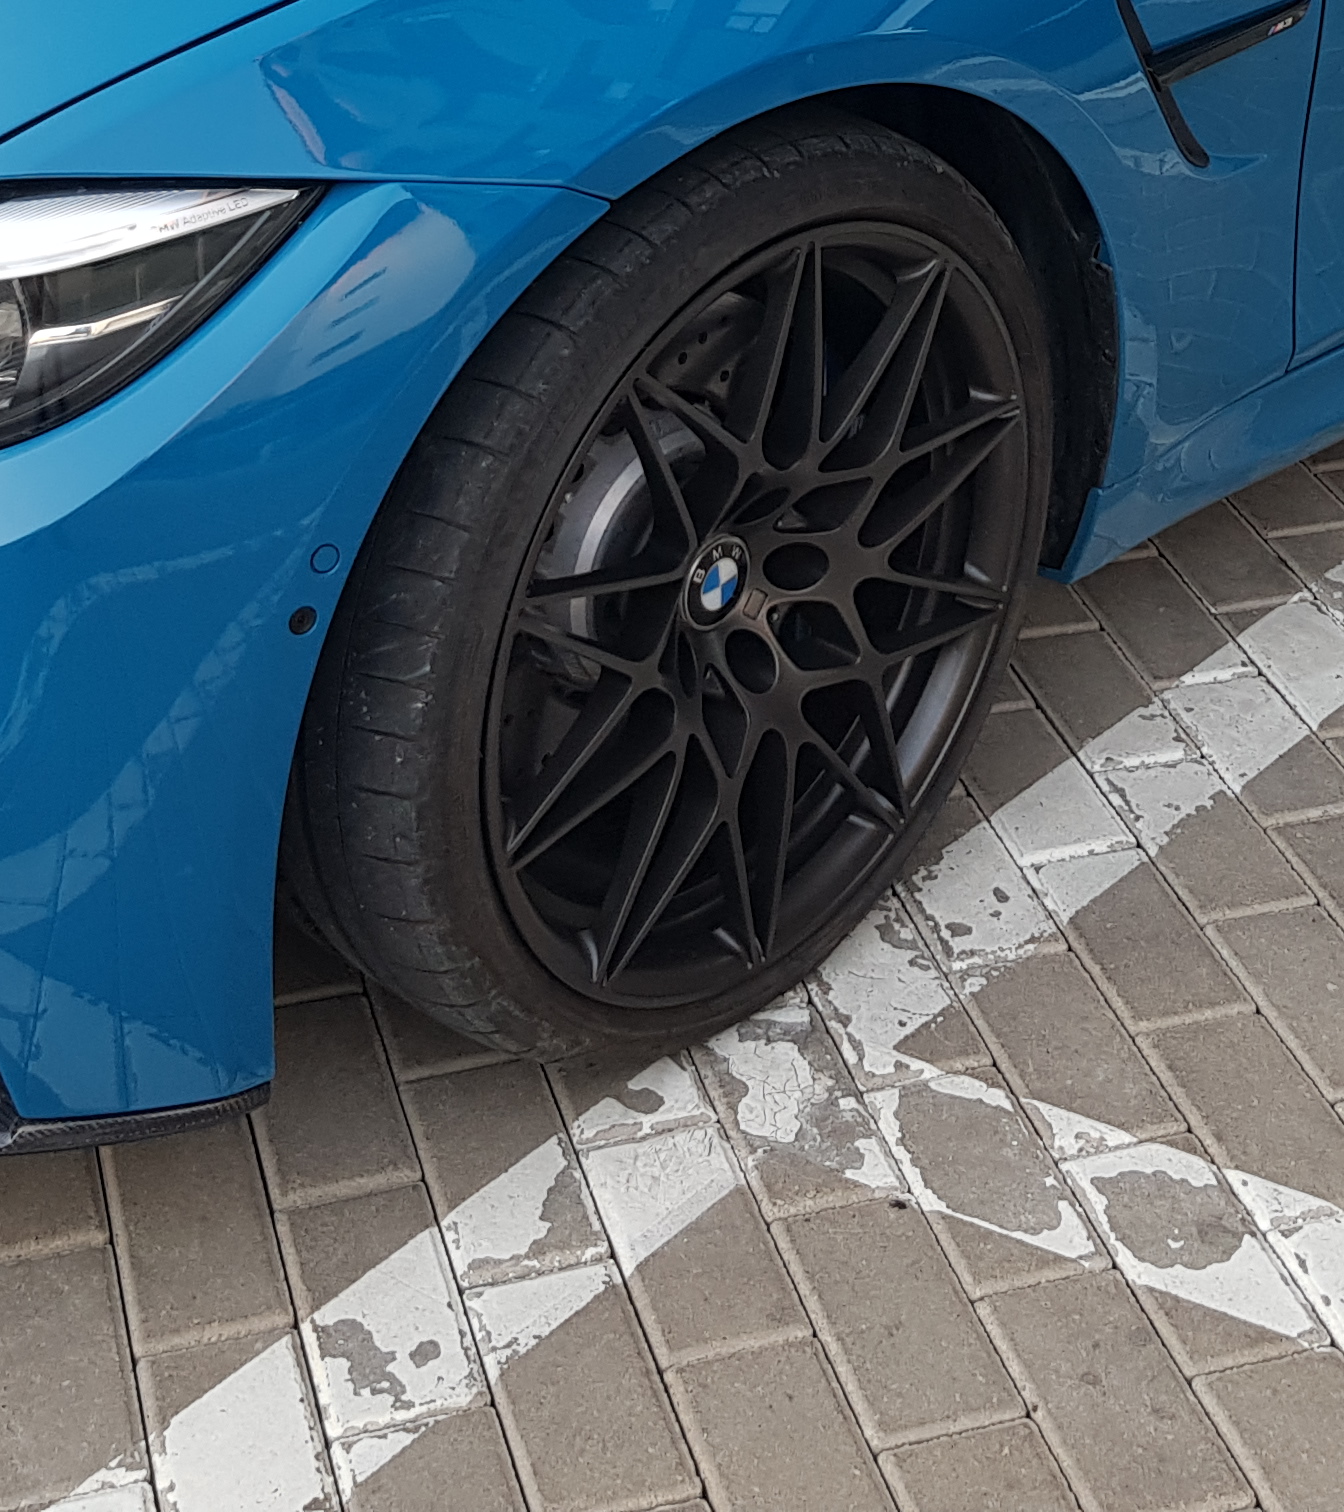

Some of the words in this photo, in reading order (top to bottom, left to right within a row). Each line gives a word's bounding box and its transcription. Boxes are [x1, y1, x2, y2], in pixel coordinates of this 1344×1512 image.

[183, 206, 226, 226] Adaptive
[227, 197, 249, 212] LED
[693, 545, 742, 583] BMW
